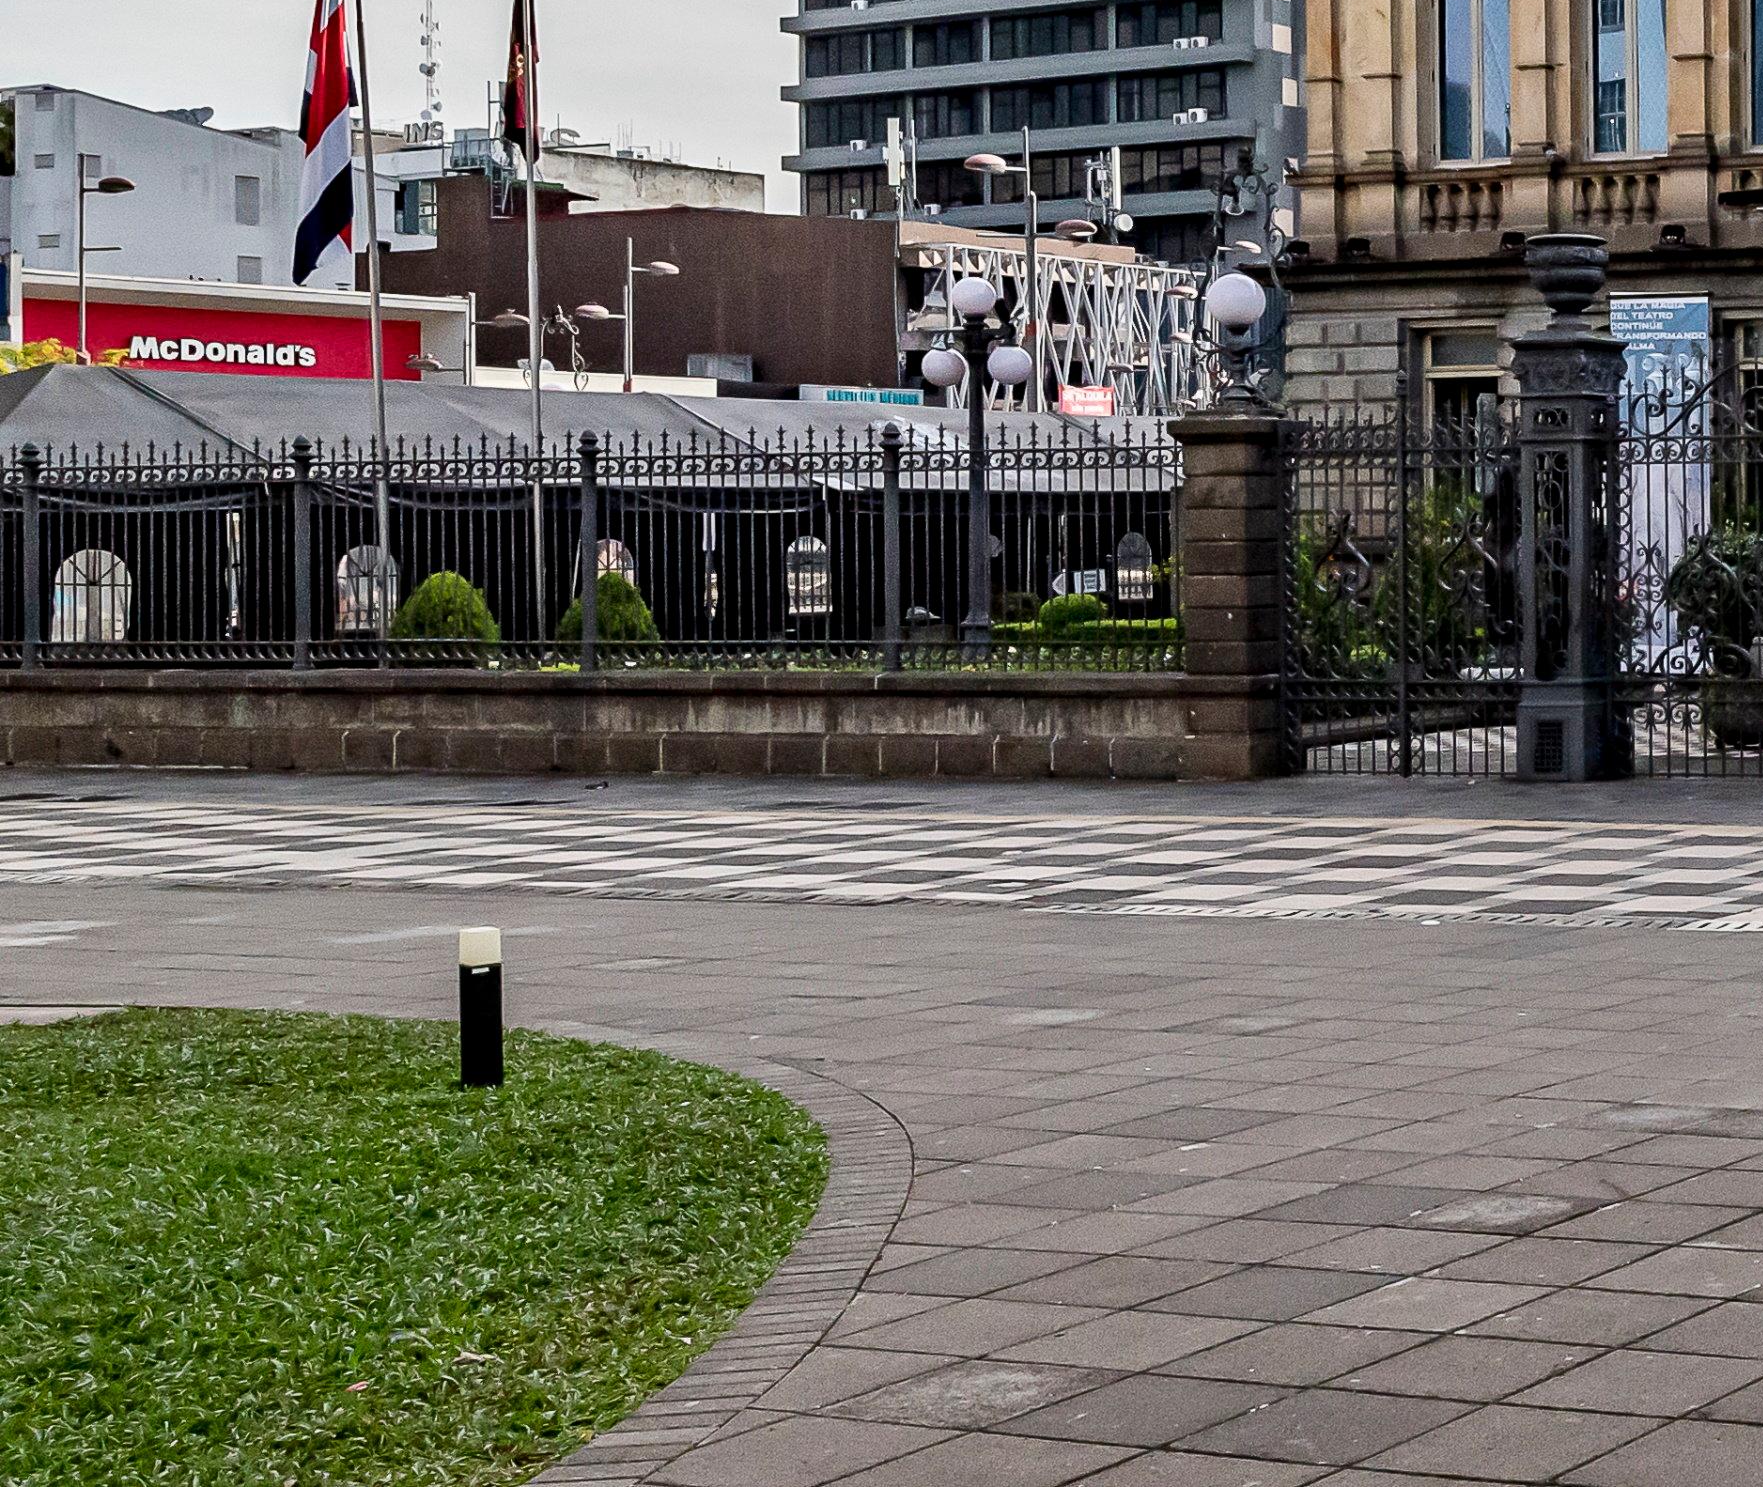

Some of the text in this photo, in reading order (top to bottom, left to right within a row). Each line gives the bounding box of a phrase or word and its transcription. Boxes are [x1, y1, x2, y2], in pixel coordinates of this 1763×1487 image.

[404, 121, 443, 143] INS
[1632, 312, 1673, 320] TEATRO
[129, 336, 316, 367] McDonald's
